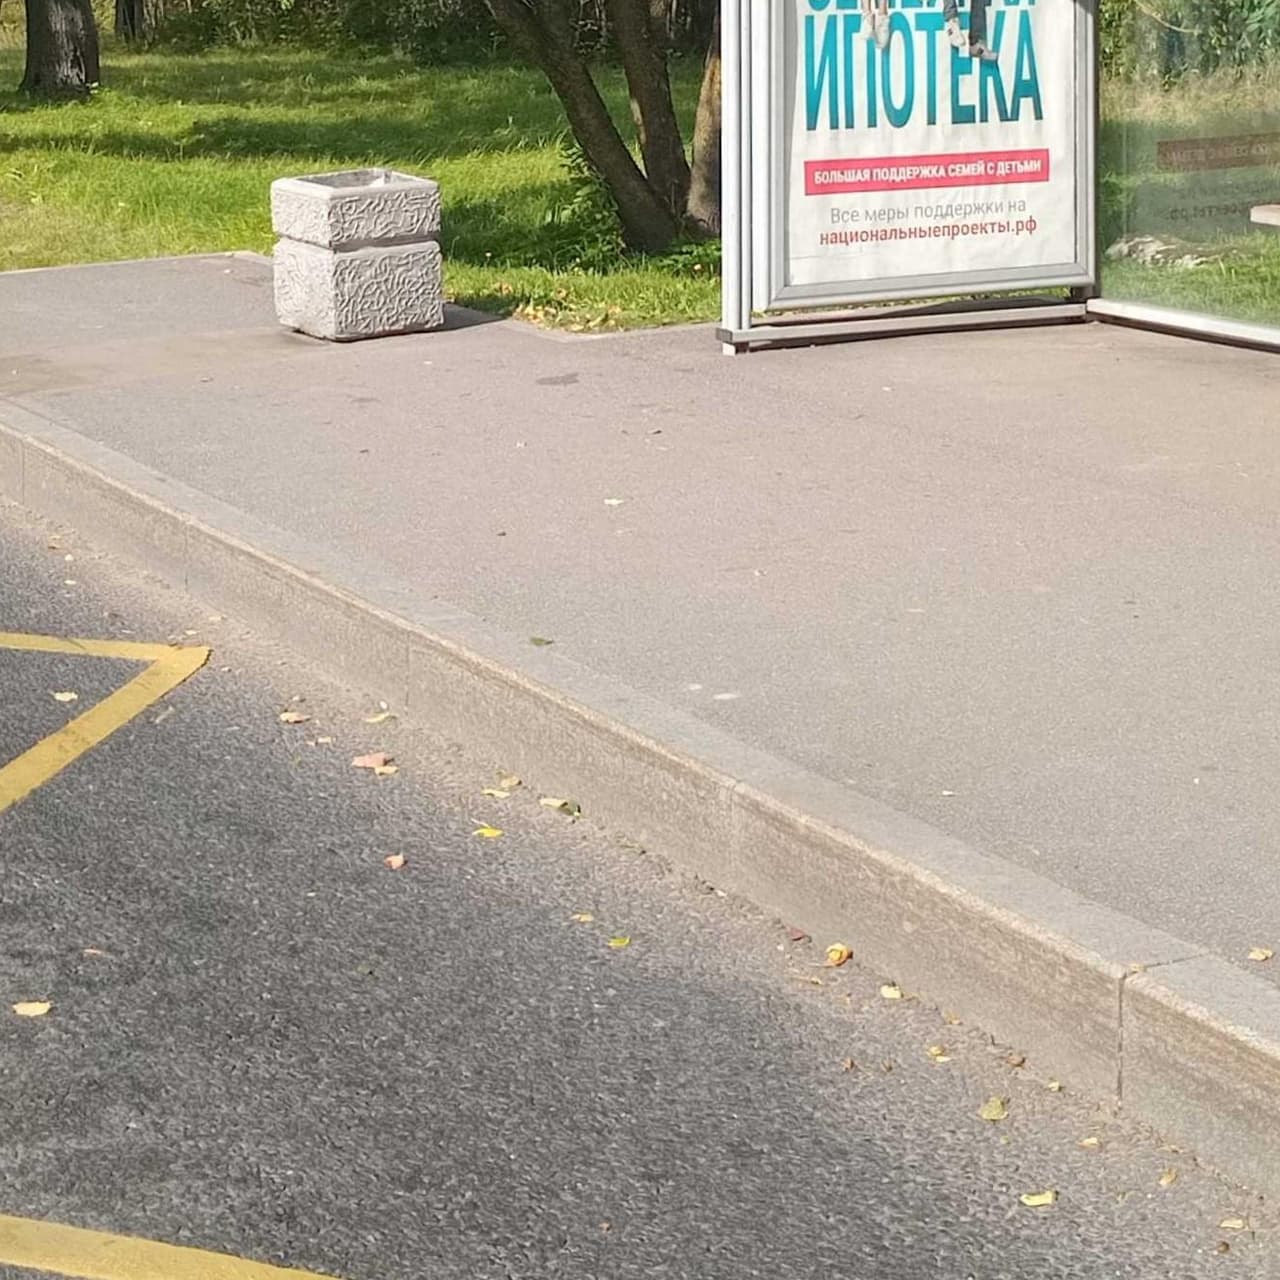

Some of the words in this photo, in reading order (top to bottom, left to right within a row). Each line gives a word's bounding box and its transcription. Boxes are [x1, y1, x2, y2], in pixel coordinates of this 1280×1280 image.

[804, 9, 1043, 131] ИПОТЕКА
[814, 168, 871, 184] БОЛЬШАЯ
[872, 164, 946, 183] ПОДДЕРЖКА
[948, 160, 985, 177] СЕМЕЙ
[986, 162, 995, 175] С
[996, 159, 1041, 176] ДЕТЬМИ
[831, 206, 860, 224] Все
[864, 206, 909, 224] меры
[914, 199, 1004, 221] поддержки
[1008, 198, 1027, 213] на
[819, 215, 1038, 246] национальныепроекты.рф
